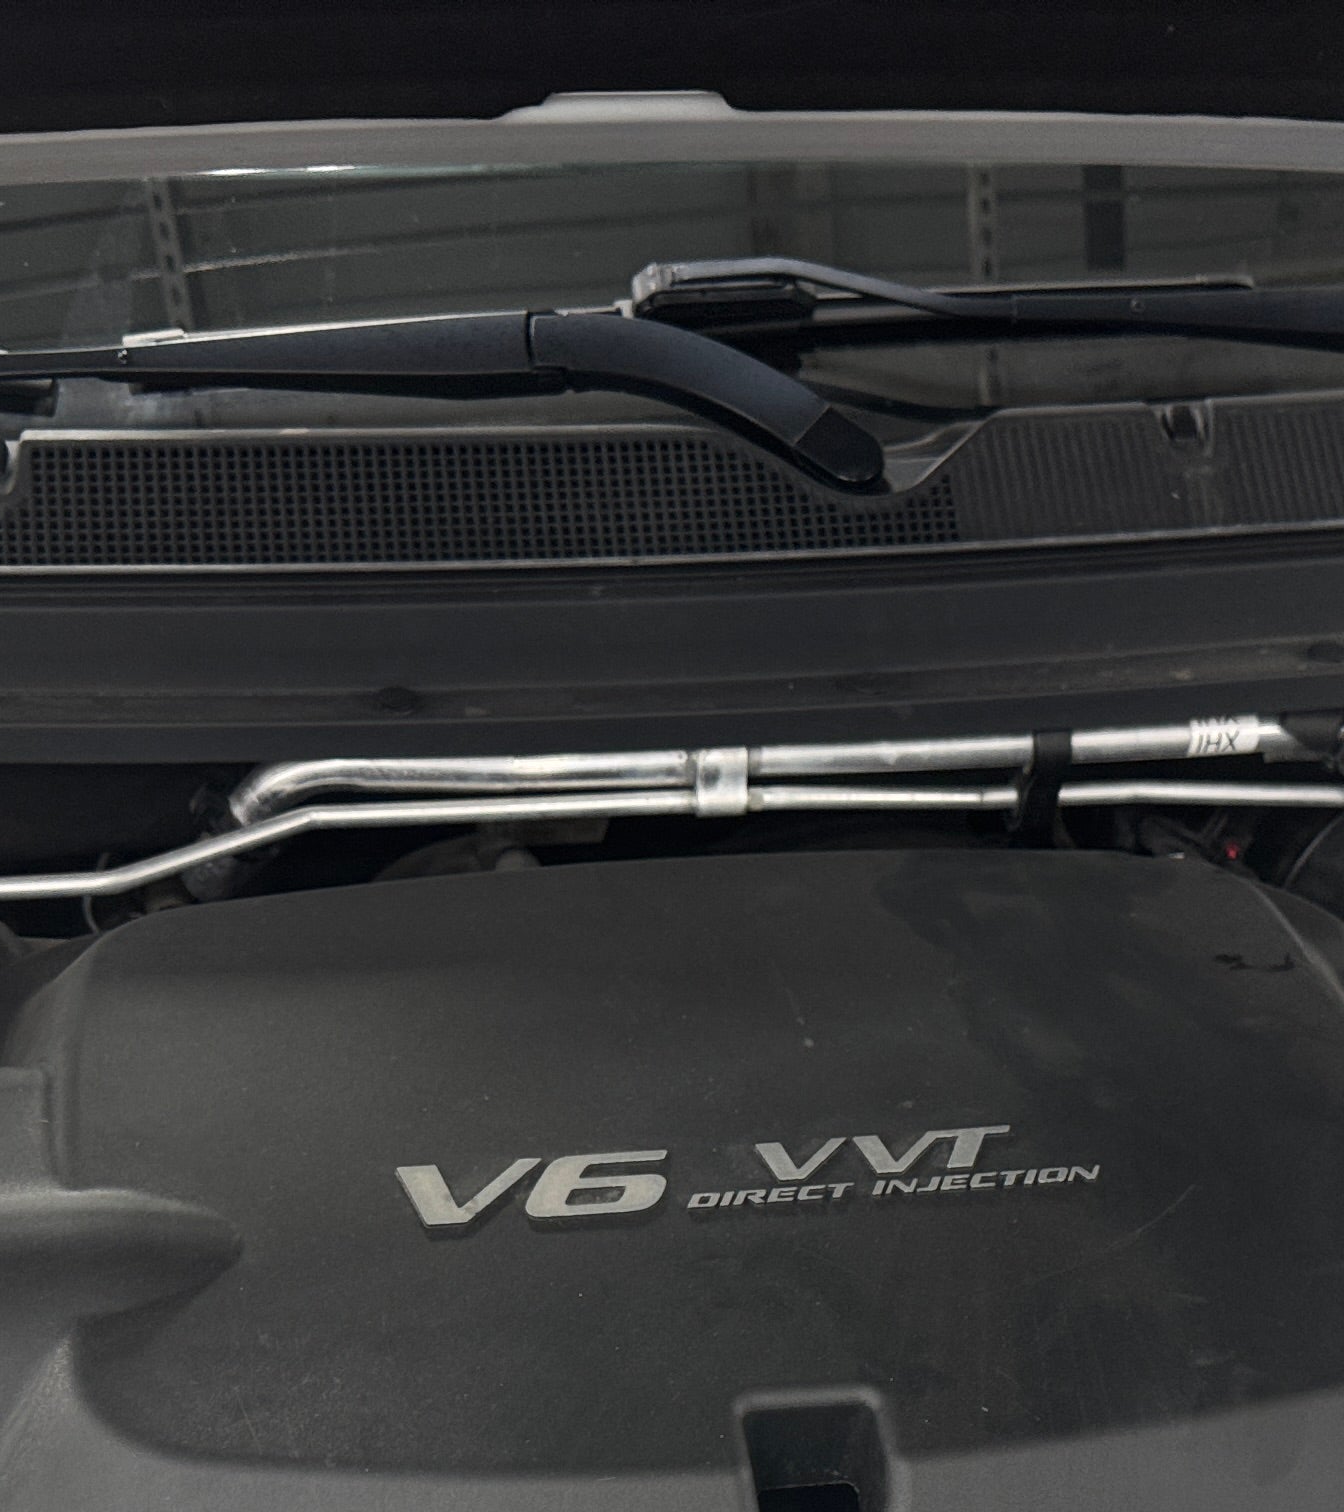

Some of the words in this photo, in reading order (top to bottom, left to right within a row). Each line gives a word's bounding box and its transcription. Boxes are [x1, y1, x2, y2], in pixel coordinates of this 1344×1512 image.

[396, 1149, 667, 1227] V6
[756, 1124, 1010, 1181] VVT
[687, 1182, 854, 1210] DIRECT
[872, 1165, 1100, 1197] INJECTION
